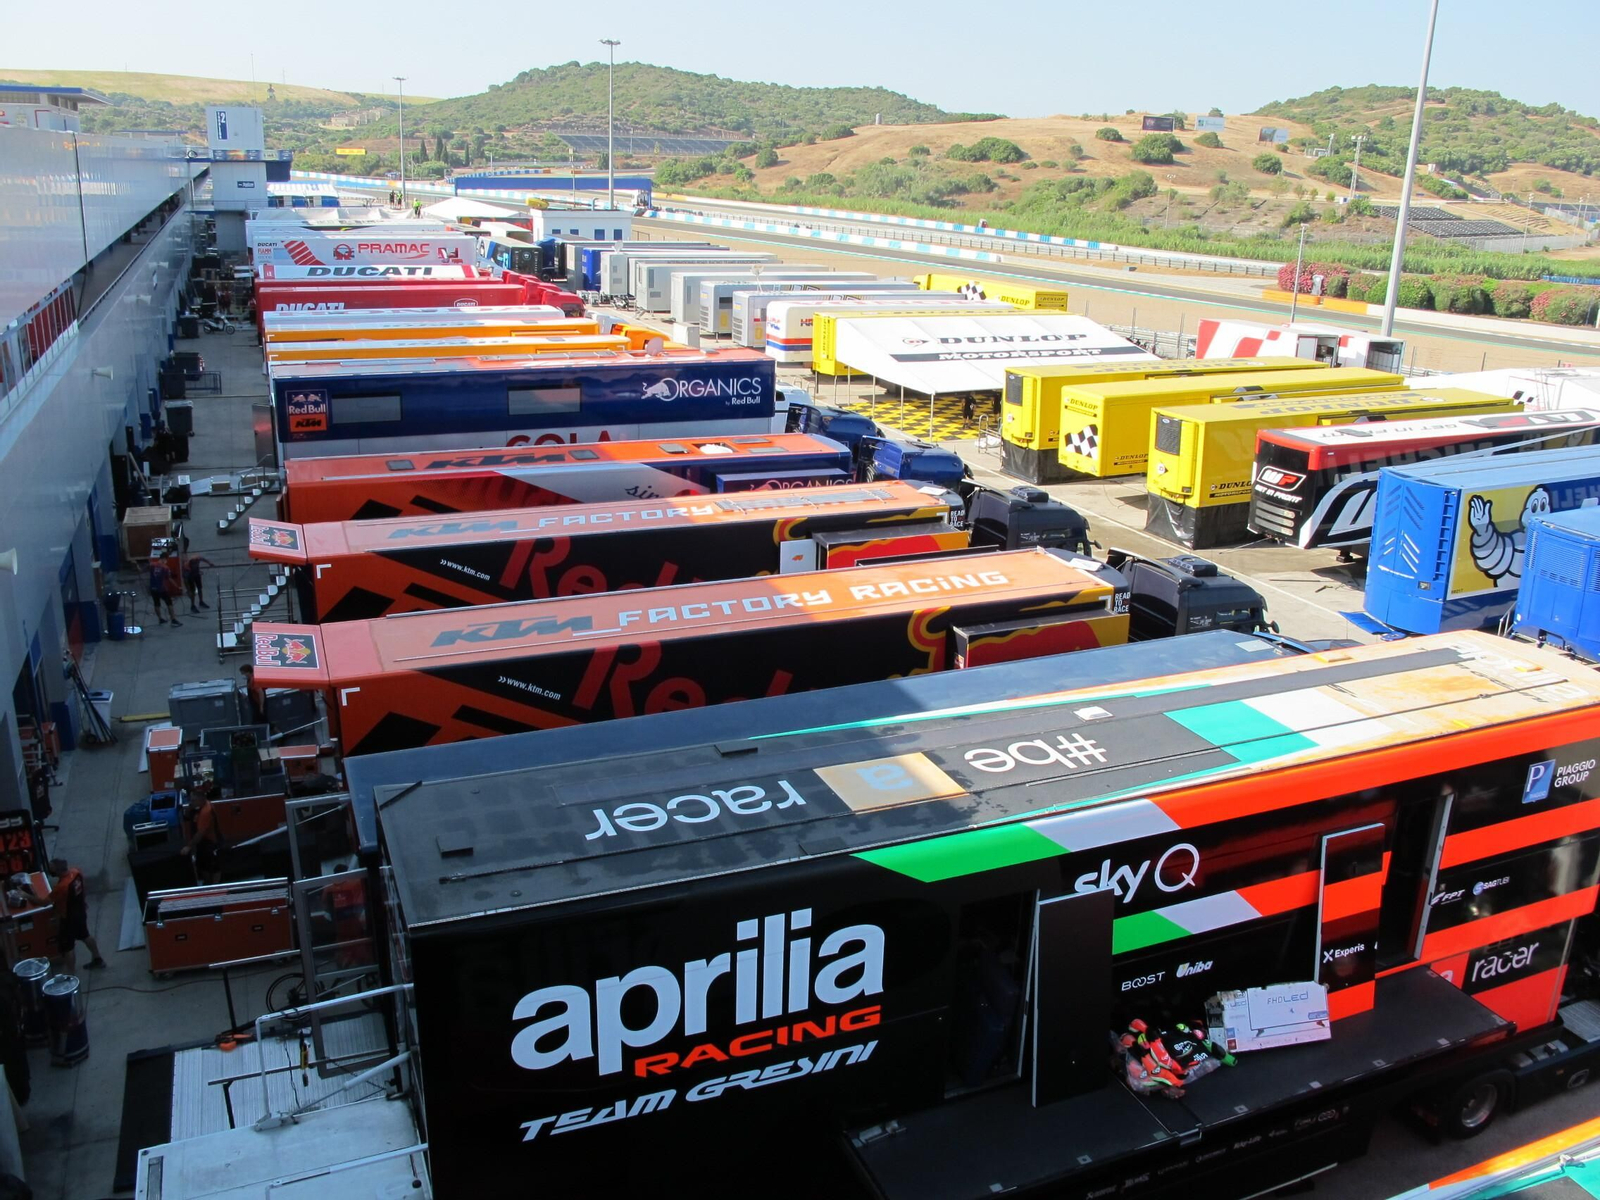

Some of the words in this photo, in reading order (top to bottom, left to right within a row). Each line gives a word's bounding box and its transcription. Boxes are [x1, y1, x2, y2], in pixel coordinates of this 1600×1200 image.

[220, 112, 226, 124] 2
[357, 243, 431, 254] PRAMAC
[306, 266, 433, 277] DUCATI
[275, 301, 345, 312] DUCATI
[1000, 295, 1030, 306] DUNLOP
[937, 333, 1088, 345] DUNLOP
[938, 348, 1102, 361] MOTORSPORT
[660, 377, 762, 402] ORGANICS
[288, 405, 306, 415] Red
[307, 403, 327, 414] Bull
[746, 396, 761, 405] Bull
[1070, 398, 1099, 410] DUNLOP
[294, 417, 323, 429] KTM
[423, 452, 566, 470] KTM
[1261, 469, 1300, 486] WP
[387, 520, 518, 539] KTM
[539, 505, 715, 528] FACTORY
[446, 561, 491, 582] www.ktm.com
[1113, 605, 1129, 613] RACE
[430, 615, 593, 648] KTM
[618, 588, 834, 628] FACTORY
[255, 634, 280, 649] Red
[254, 648, 281, 666] Bull
[506, 675, 561, 701] www.ktm.com
[962, 732, 1110, 773] #be
[1556, 759, 1597, 778] PIAGGIO
[1554, 771, 1590, 788] GROUP
[585, 779, 808, 842] racer
[1074, 858, 1151, 904] sky
[1154, 843, 1200, 893] Q
[1441, 889, 1466, 902] FPT
[1334, 943, 1365, 959] Experis
[1175, 960, 1214, 979] Uniba
[1471, 941, 1540, 982] racer
[1121, 971, 1166, 991] BOOST
[510, 906, 887, 1076] aprilia
[634, 1004, 883, 1079] RACING
[518, 1088, 677, 1143] TEAM
[685, 1039, 880, 1103] GRESINI
